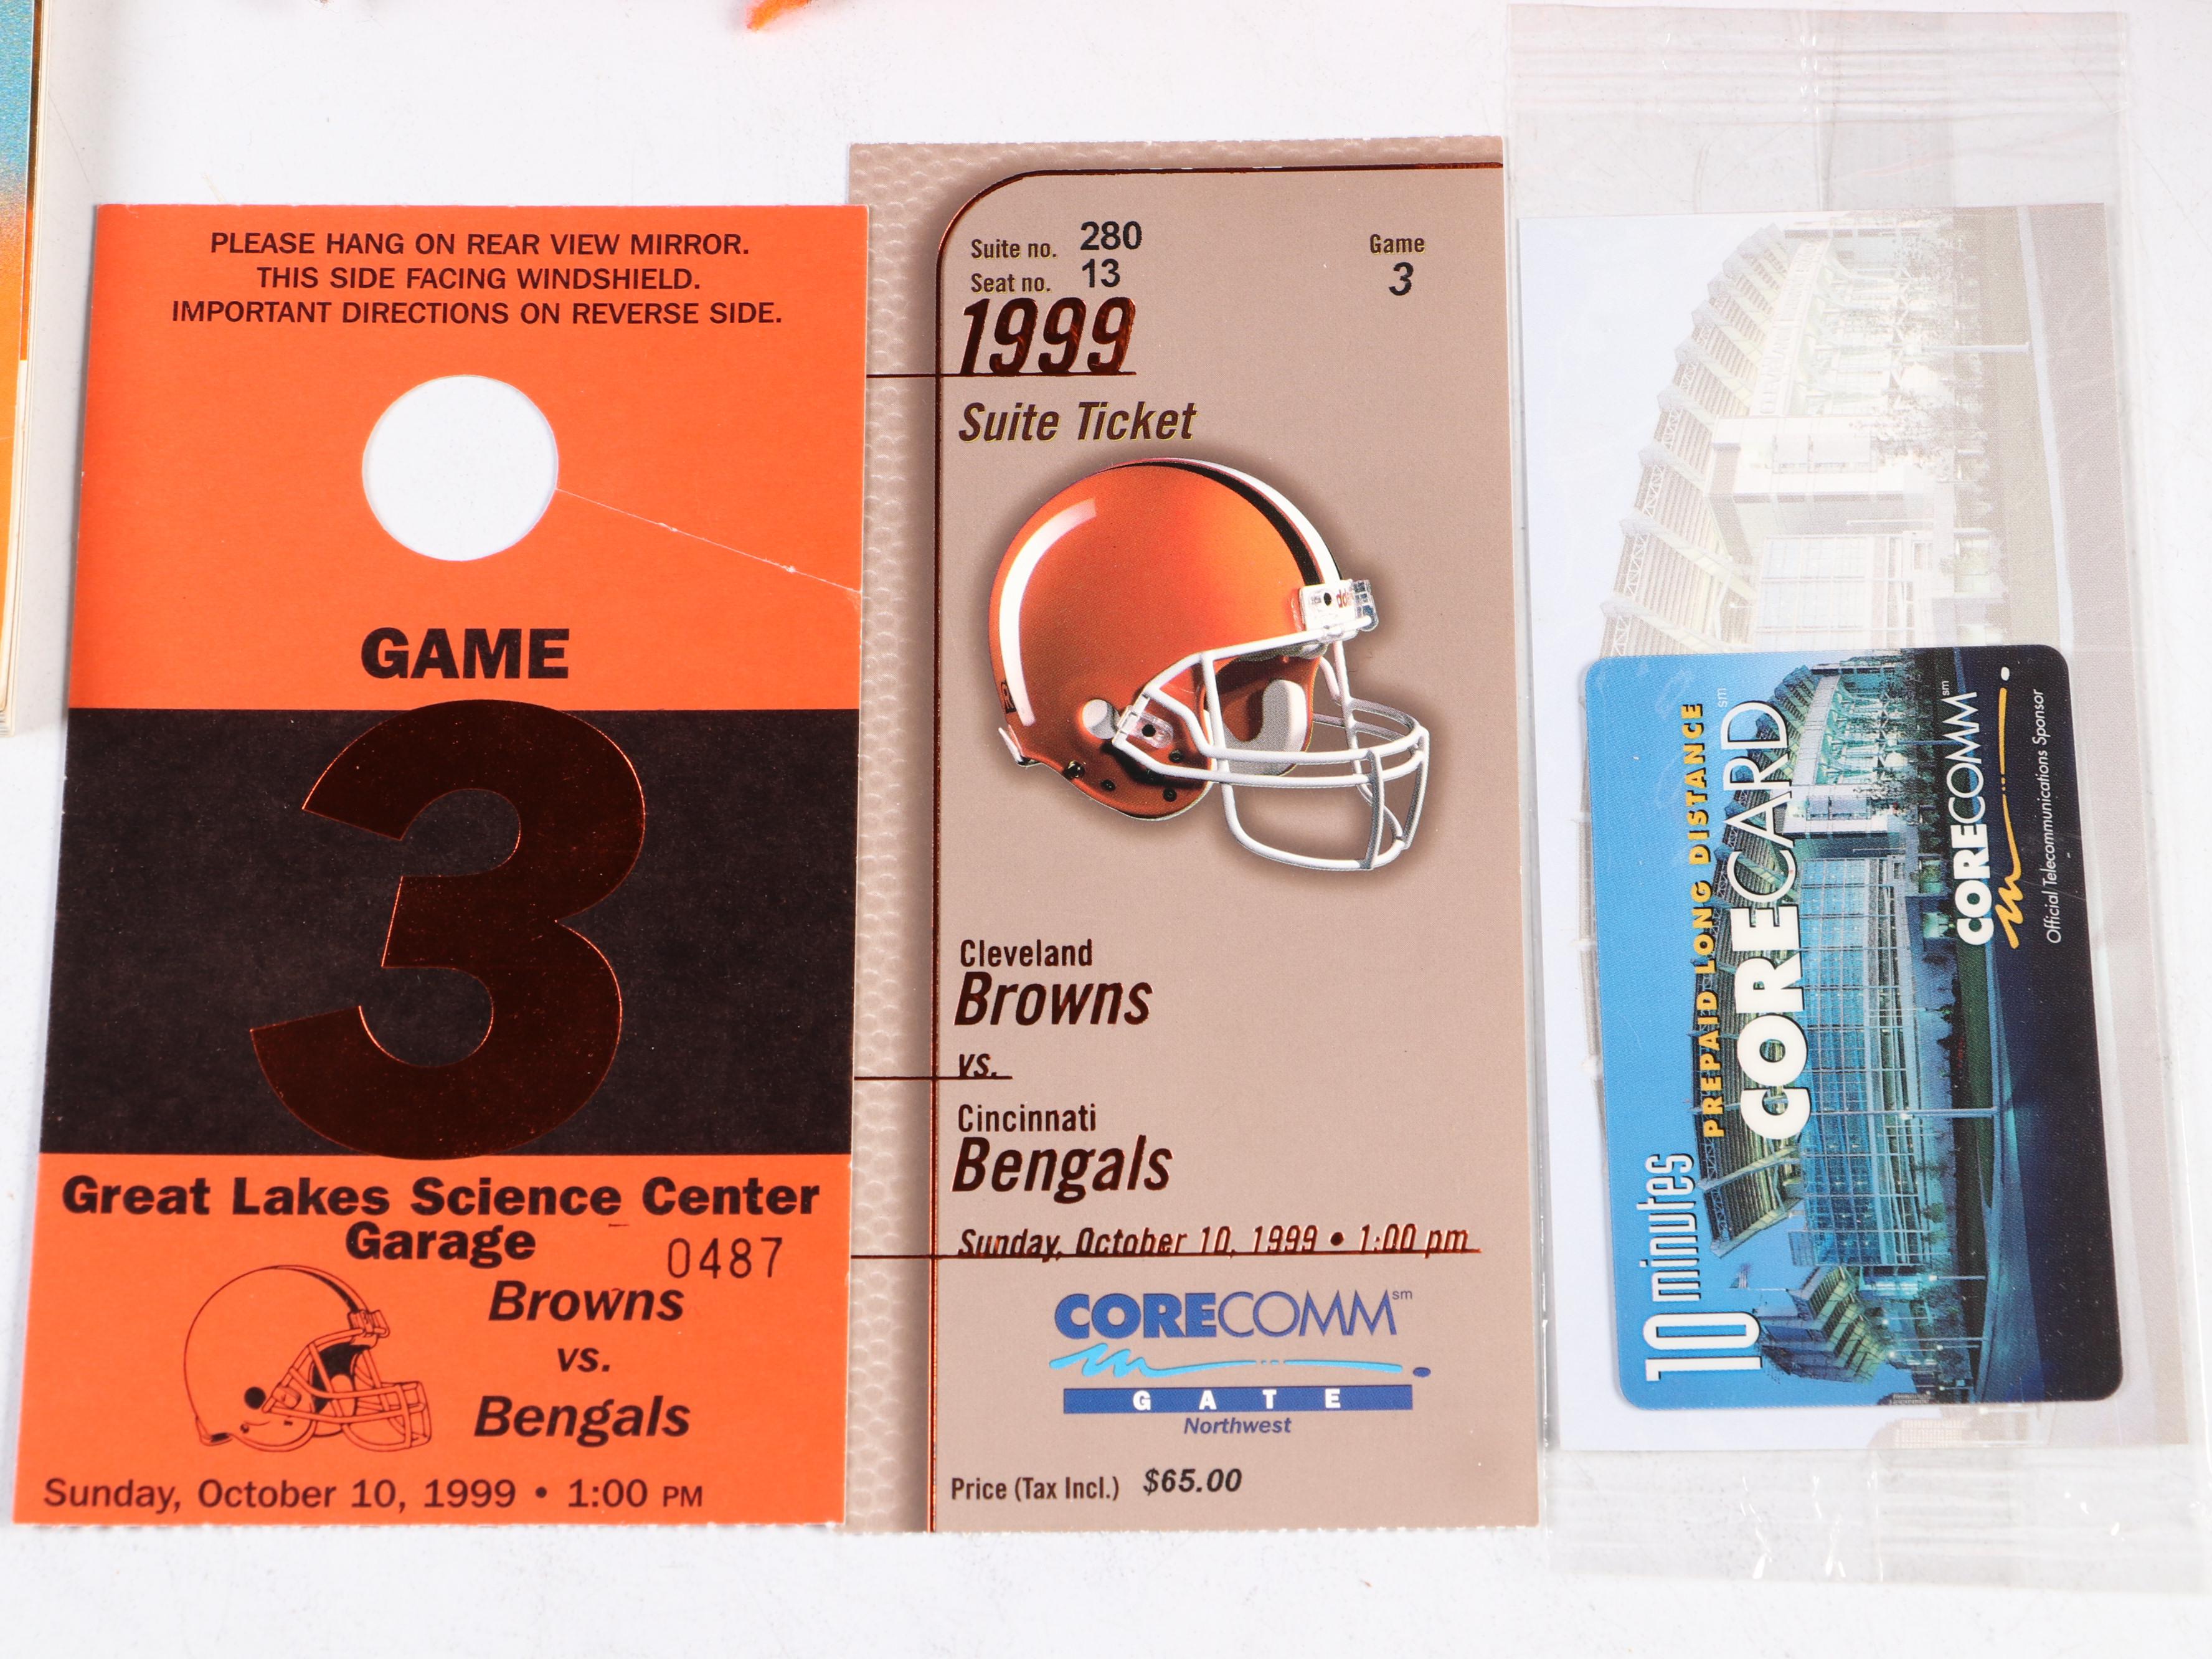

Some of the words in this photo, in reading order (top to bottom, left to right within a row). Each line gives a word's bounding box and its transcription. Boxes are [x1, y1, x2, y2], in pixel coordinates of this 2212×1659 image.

[212, 232, 314, 253] PLEASE
[327, 234, 404, 254] HANG
[416, 234, 454, 254] ON
[468, 234, 539, 254] REAR
[551, 234, 620, 255] VIEW
[631, 234, 748, 255] MIRROR.
[971, 239, 1019, 258] Suite
[1028, 240, 1057, 259] no.
[1080, 221, 1142, 250] 280
[1370, 234, 1424, 253] Game
[257, 267, 318, 288] THIS
[330, 267, 395, 288] SIDE
[407, 268, 505, 289] FACING
[517, 268, 699, 289] WINDSHIELD.
[971, 273, 1014, 292] Seat
[1021, 275, 1051, 294] no.
[1082, 258, 1120, 288] 13
[1389, 262, 1414, 296] 3
[173, 301, 331, 323] IMPORTANT
[343, 302, 508, 324] DIRECTIONS
[521, 303, 559, 324] ON
[573, 303, 699, 324] REVERSE
[710, 303, 781, 323] SIDE.
[960, 297, 1136, 375] 1999
[959, 402, 1059, 441] Suite
[1078, 402, 1197, 440] Ticket
[361, 628, 569, 679] GAME
[2033, 688, 2051, 745] Sponsor
[1683, 702, 1709, 865] DISTANCE
[1942, 691, 1993, 945] CORECOMM
[2036, 745, 2059, 886] Telecommunications
[250, 700, 646, 1160] 3
[1693, 882, 1716, 973] LONG
[1722, 701, 1812, 1141] CORECARD
[2042, 883, 2061, 944] Official
[961, 939, 1092, 967] Cleveland
[955, 971, 1152, 1026] Browns
[958, 1053, 998, 1079] vs.
[1698, 990, 1726, 1138] PREPAID
[958, 1104, 1095, 1132] Cincinnati
[952, 1135, 1172, 1204] Bengals
[63, 1175, 210, 1215] Great
[233, 1178, 389, 1216] Lakes
[411, 1177, 621, 1216] Science
[643, 1177, 820, 1215] Center
[346, 1221, 536, 1269] Garage
[958, 1228, 1063, 1263] Sunday,
[1076, 1227, 1188, 1255] October
[1199, 1226, 1234, 1258] 10,
[1252, 1225, 1319, 1253] 1999
[1359, 1224, 1416, 1252] 1:00
[1423, 1230, 1470, 1258] pm
[1637, 1154, 1700, 1303] minutes
[668, 1237, 782, 1279] 0487
[489, 1280, 684, 1321] Browns
[1054, 1290, 1399, 1339] CORECOMM
[558, 1348, 610, 1372] vs.
[1643, 1311, 1762, 1382] 10
[475, 1396, 690, 1447] Bengals
[1184, 1417, 1292, 1434] Northwest
[44, 1478, 180, 1514] Sunday,
[199, 1479, 336, 1508] October
[352, 1480, 405, 1513] 10,
[425, 1479, 516, 1508] 1999
[569, 1479, 648, 1507] 1:00
[663, 1486, 702, 1507] PM
[952, 1478, 1006, 1500] Price
[1015, 1477, 1057, 1501] (Tax
[1066, 1477, 1118, 1501] Incl.)
[1143, 1468, 1242, 1495] $65.00
